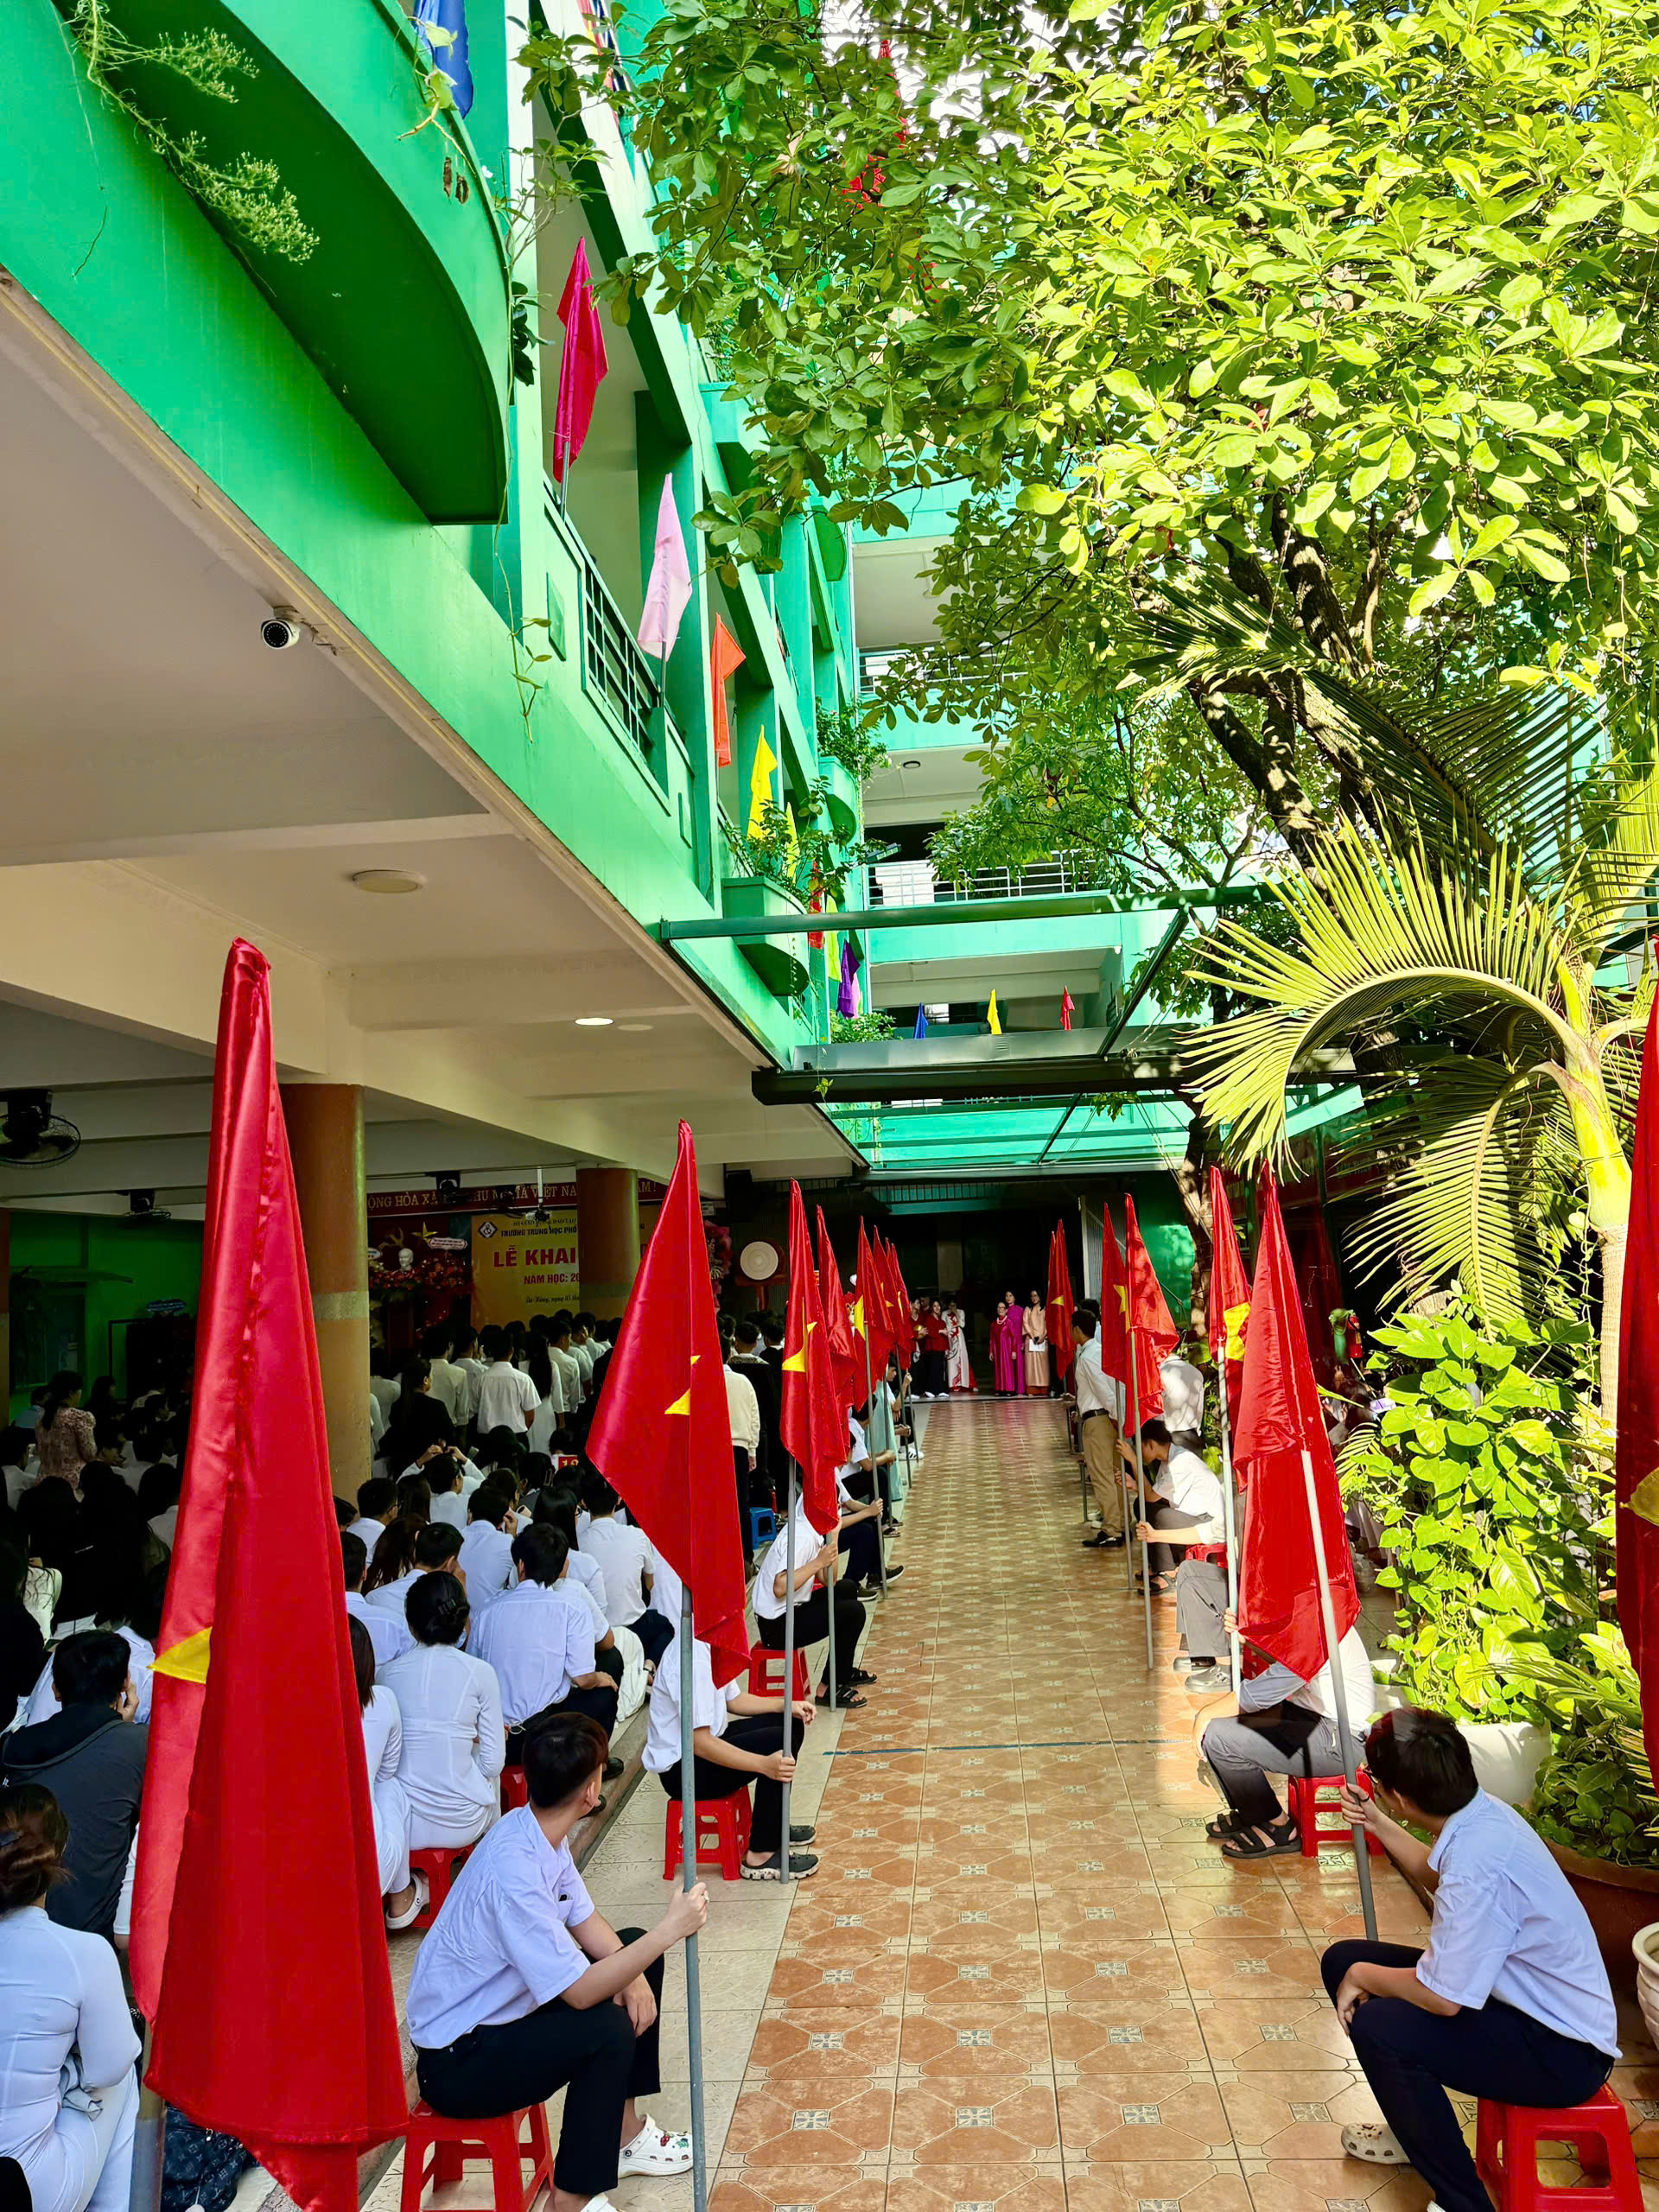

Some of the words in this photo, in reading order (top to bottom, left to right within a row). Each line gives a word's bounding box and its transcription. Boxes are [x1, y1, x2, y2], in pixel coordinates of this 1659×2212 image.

[394, 1192, 420, 1207] HÒA
[527, 1227, 548, 1236] TRUNG
[493, 1244, 518, 1268] LỄ
[525, 1247, 576, 1266] KHAI
[547, 1273, 568, 1285] HỌC:
